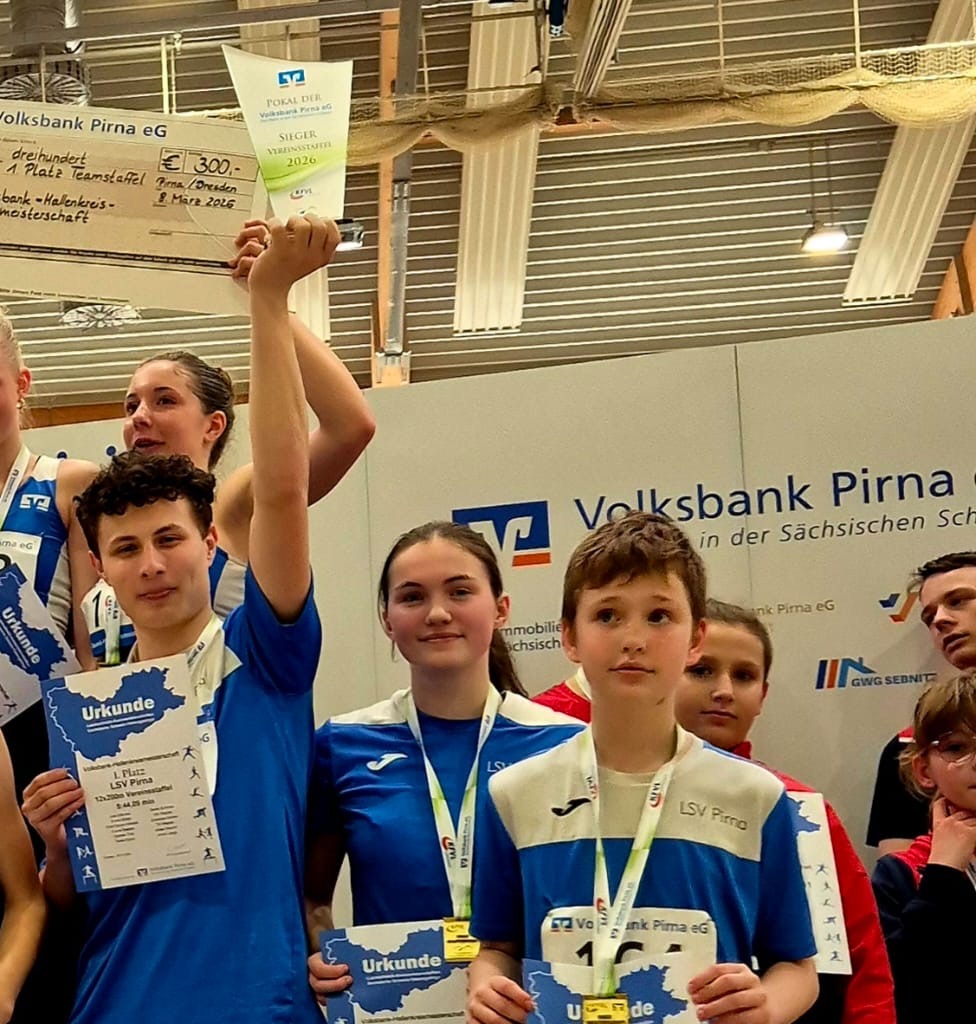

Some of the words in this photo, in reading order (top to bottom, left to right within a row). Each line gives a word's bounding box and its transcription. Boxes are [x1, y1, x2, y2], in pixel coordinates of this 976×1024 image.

[90, 118, 136, 135] Pirna
[143, 124, 167, 138] eG
[12, 146, 86, 165] dreihundert
[161, 154, 180, 171] €
[287, 155, 317, 168] 2026
[24, 162, 63, 178] Platz
[71, 165, 146, 186] Teamstaffel
[574, 475, 814, 529] Volksbank
[831, 468, 954, 507] Pirna
[699, 531, 719, 549] in
[731, 527, 770, 547] der
[779, 514, 925, 542] Sächsischen
[816, 599, 835, 612] eG
[1, 606, 41, 664] Urkunde
[499, 621, 563, 636] mmobilie
[506, 637, 561, 652] chsisch
[81, 696, 155, 721] Urkunde
[487, 761, 512, 772] LS
[109, 780, 128, 790] LSV
[129, 777, 153, 786] Pirna
[679, 801, 706, 817] LSV
[711, 807, 748, 831] Pirna
[652, 919, 687, 932] Pirna
[691, 922, 708, 934] eG
[362, 953, 442, 973] Urkunde
